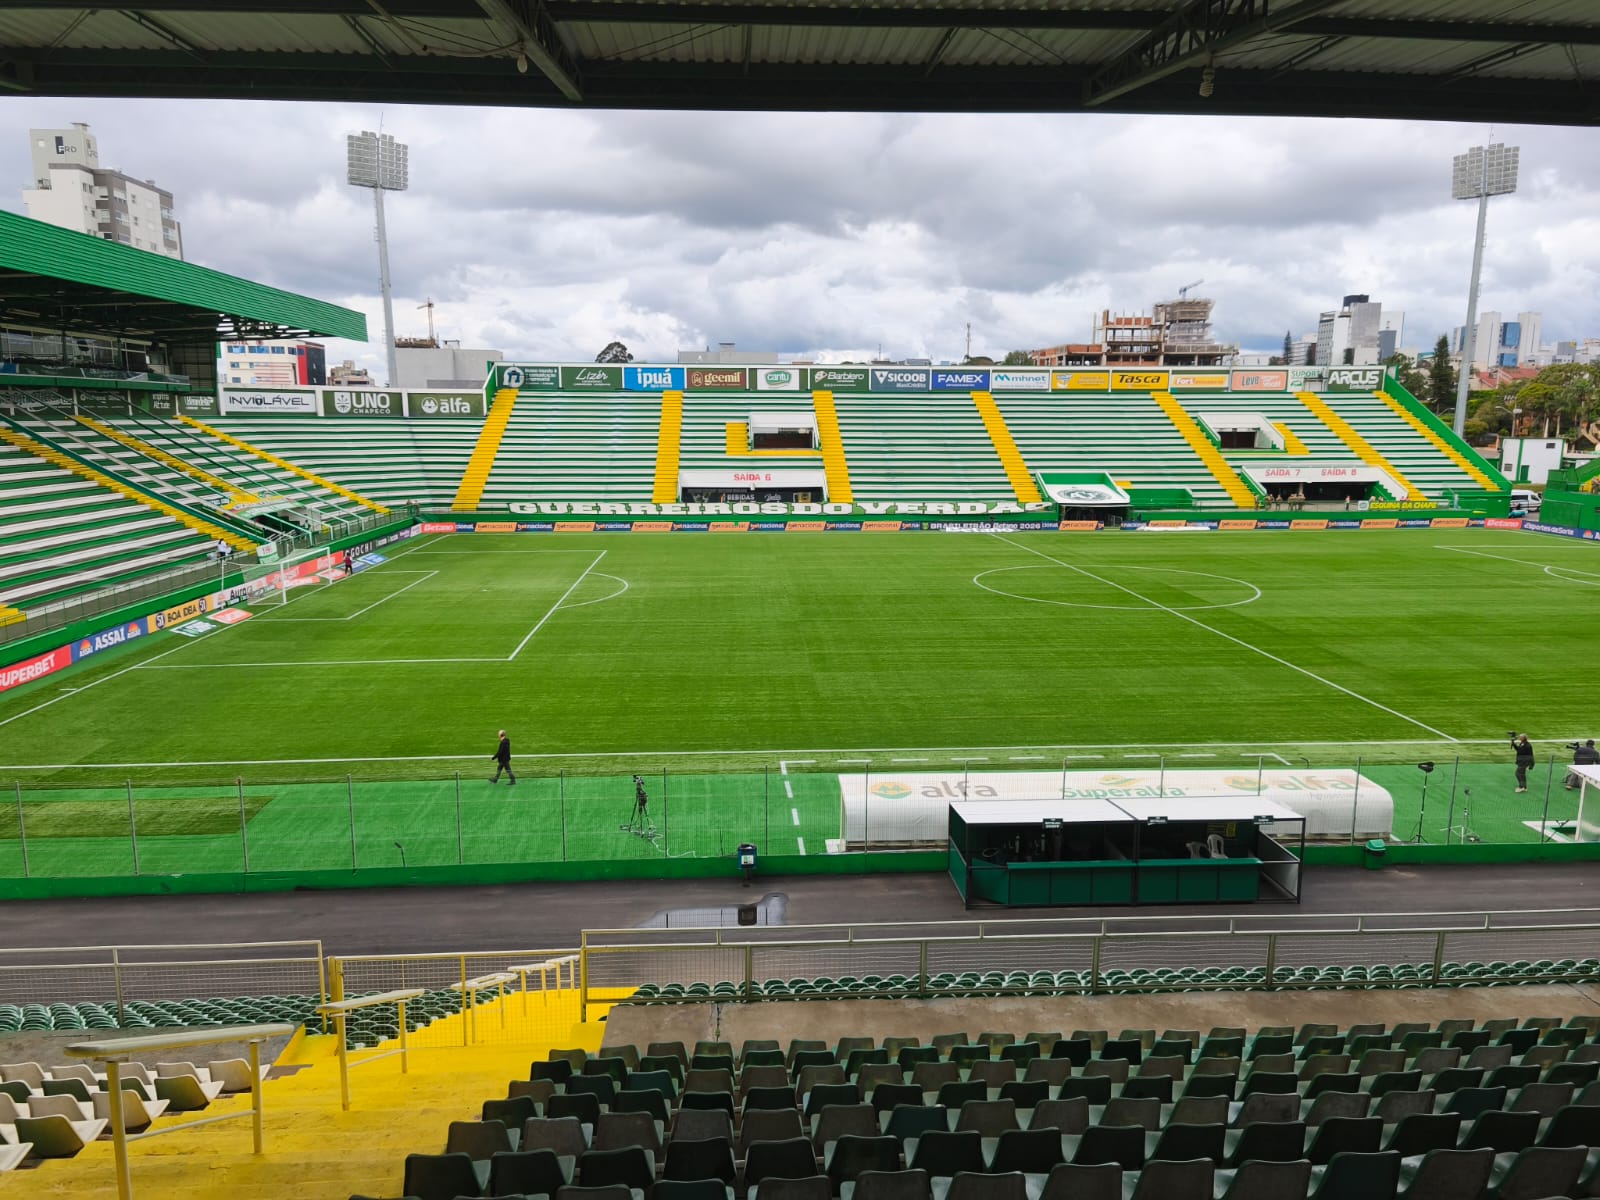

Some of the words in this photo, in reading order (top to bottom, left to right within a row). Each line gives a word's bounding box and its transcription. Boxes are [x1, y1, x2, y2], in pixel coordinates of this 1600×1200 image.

[637, 368, 672, 388] ipuá
[704, 372, 742, 386] geemil
[767, 373, 789, 383] cantu
[828, 371, 865, 380] Barbiero
[888, 373, 926, 382] SICOOB
[938, 374, 983, 383] FAMEX
[1119, 374, 1160, 383] Tasca
[1291, 370, 1323, 379] SUPORT
[1328, 370, 1379, 385] ARCUS
[229, 394, 310, 406] INVIOLÁVEL
[352, 393, 390, 408] UNO
[440, 397, 471, 414] alfa
[734, 473, 761, 481] SAÍDA
[1265, 467, 1290, 477] SAÍDA
[1295, 468, 1301, 476] 7
[1321, 467, 1346, 477] SAÍDA
[156, 615, 165, 628] 51
[167, 612, 181, 622] BOA
[1272, 775, 1357, 790] alfa
[921, 781, 998, 798] alfa
[1059, 786, 1186, 799] Superalfa
